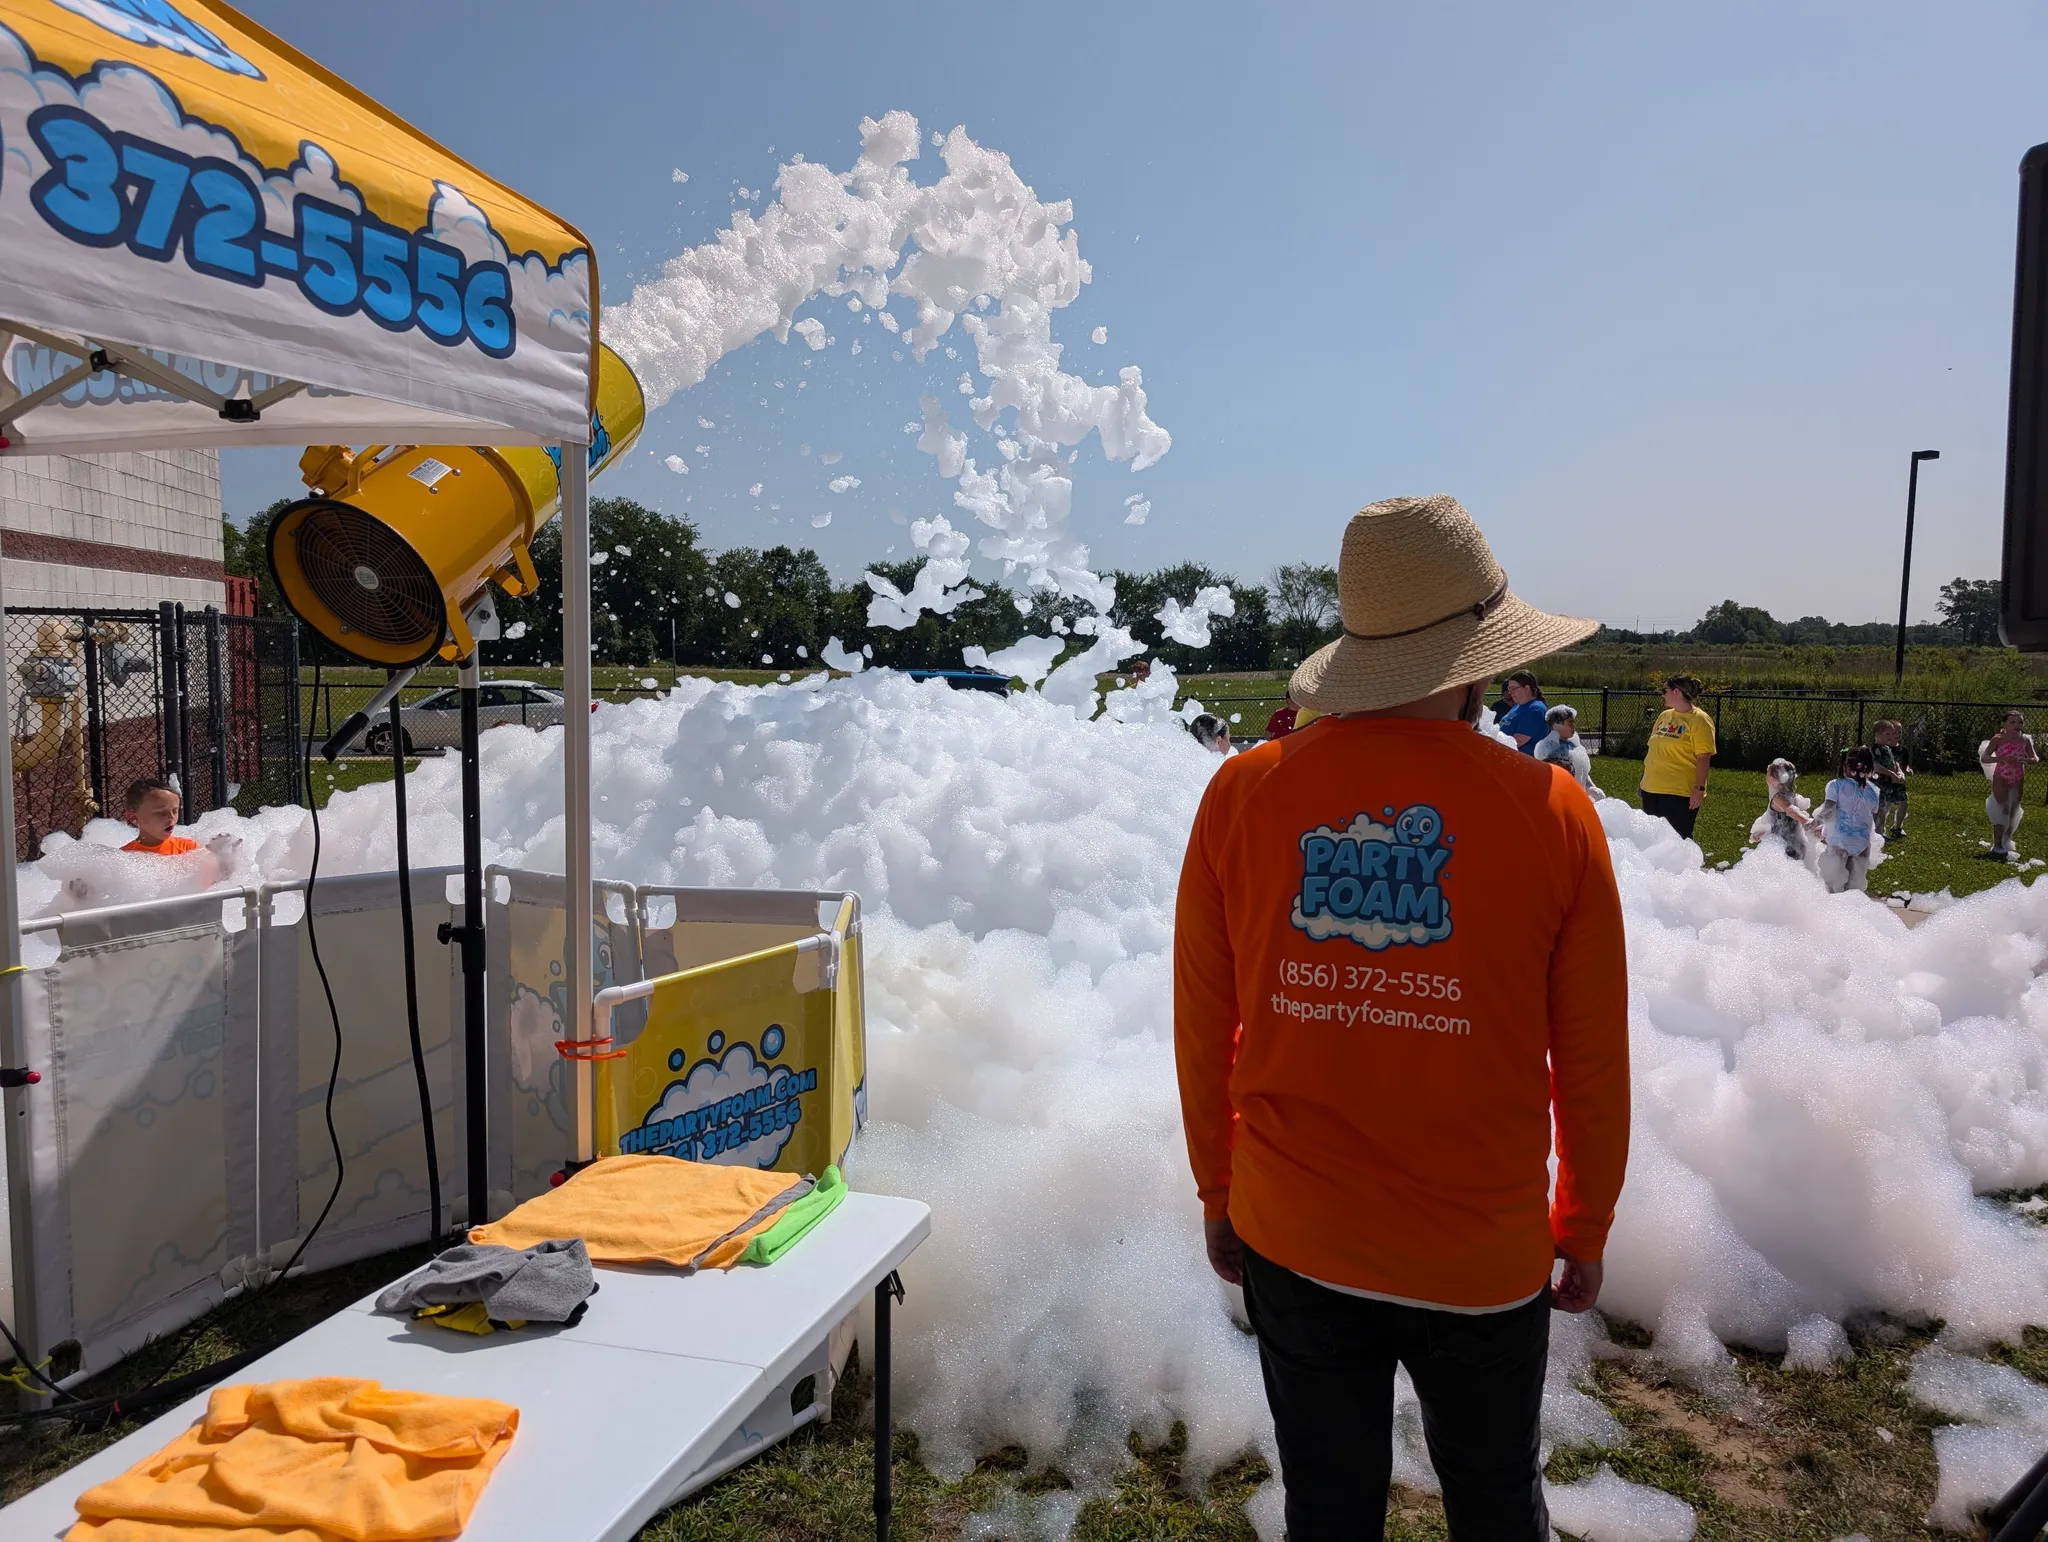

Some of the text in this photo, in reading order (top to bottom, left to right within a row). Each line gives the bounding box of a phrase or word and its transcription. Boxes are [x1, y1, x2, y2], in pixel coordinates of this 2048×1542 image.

[28, 105, 516, 358] 372-5556
[1305, 837, 1449, 884] PARTY
[1303, 876, 1440, 925] FOAM
[1279, 958, 1462, 1002] (856) 372-5556
[1271, 991, 1471, 1035] thepartyfoam.com
[619, 1068, 817, 1155] THEPARTYFOAM.COM
[701, 1098, 802, 1160] 372-5556
